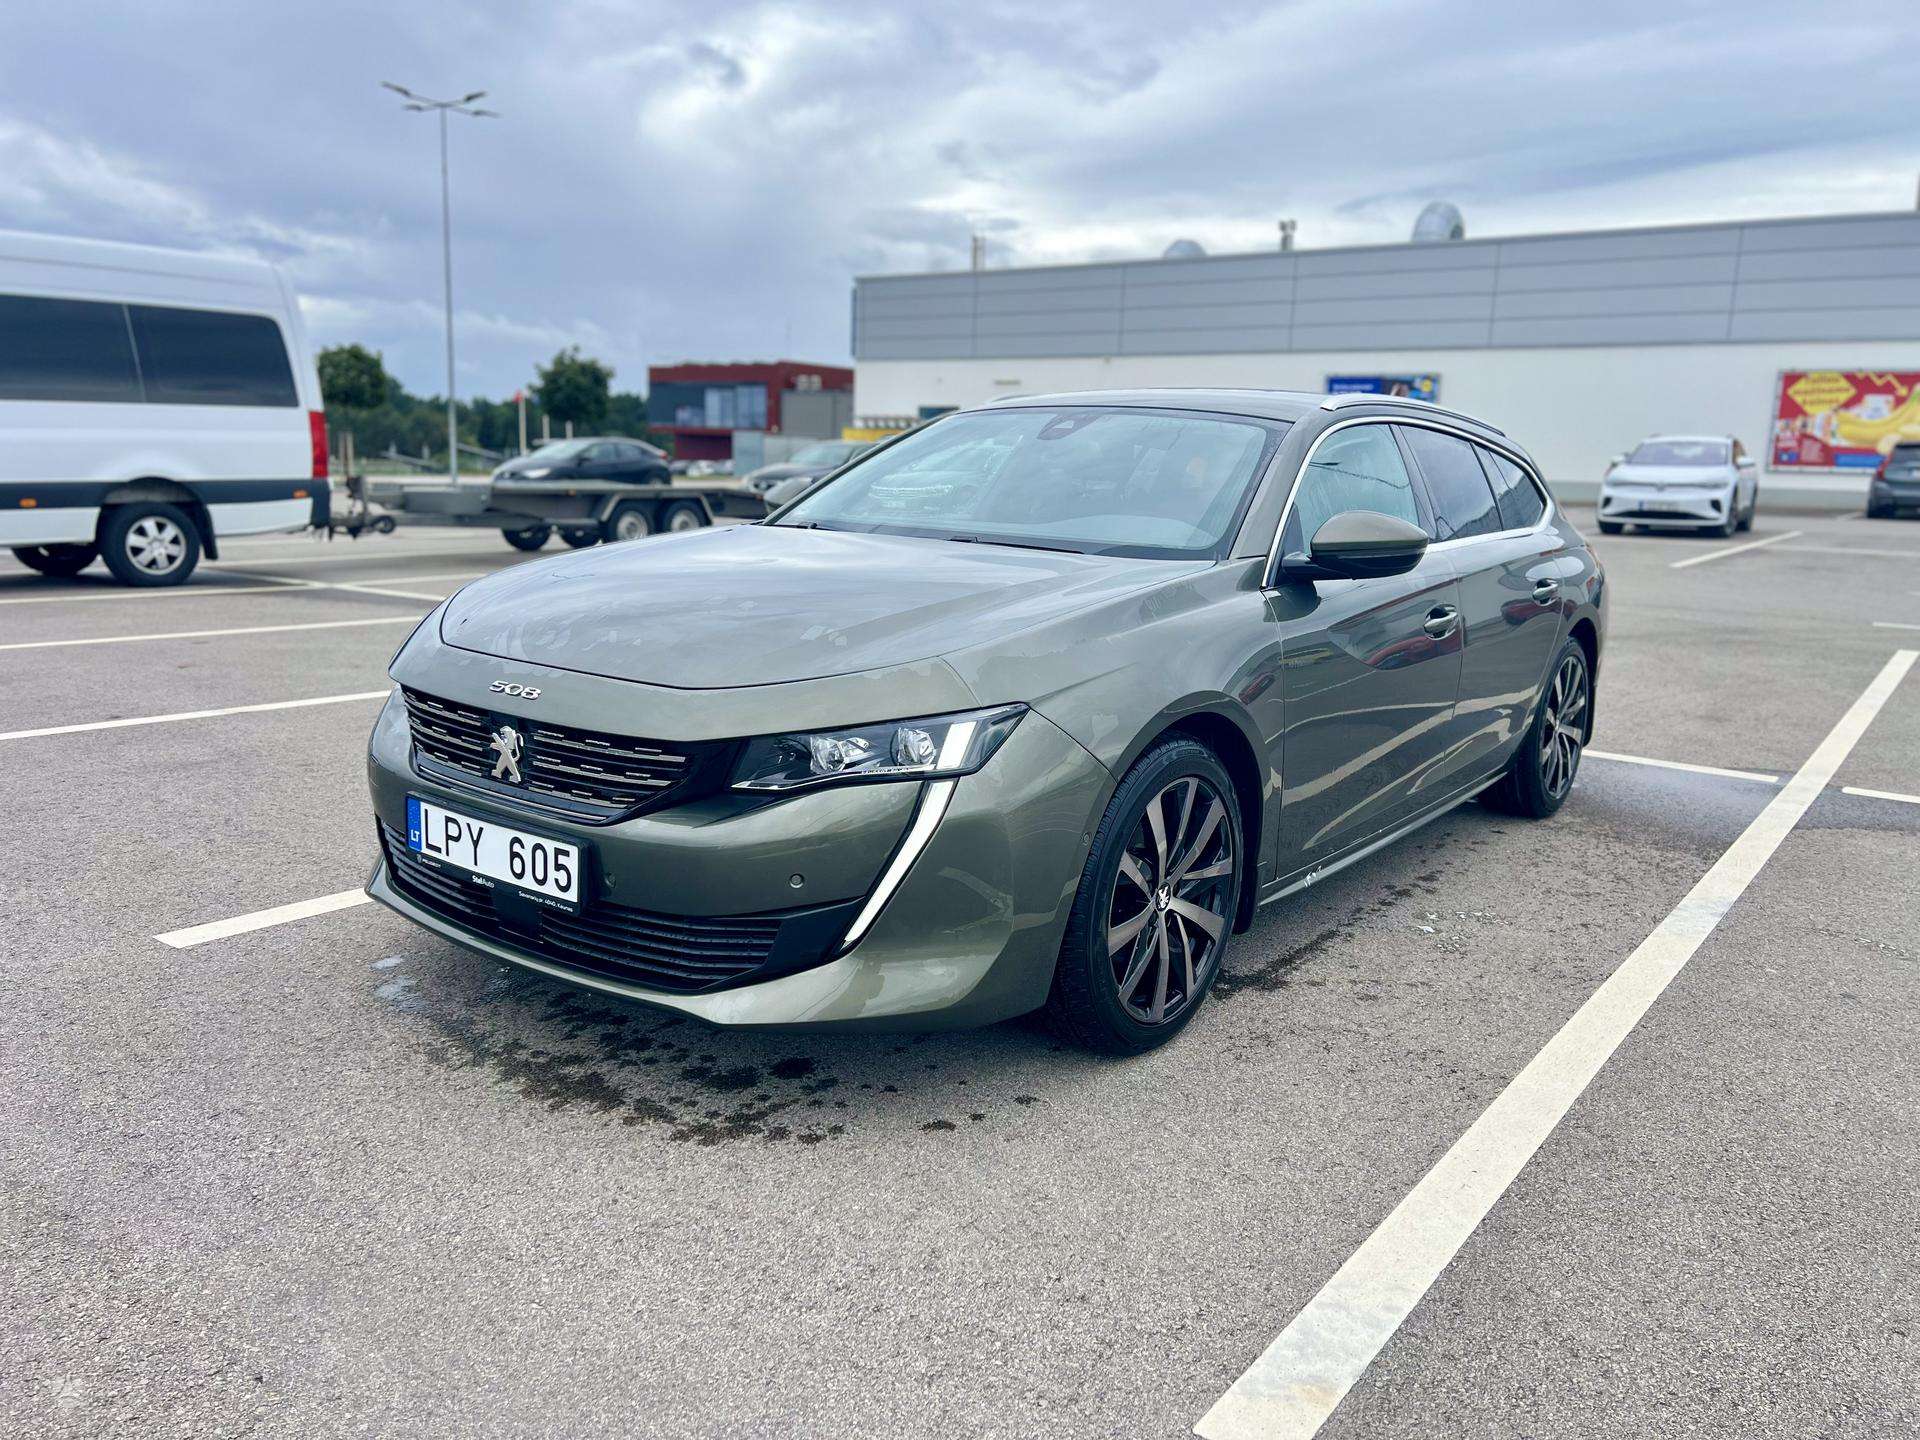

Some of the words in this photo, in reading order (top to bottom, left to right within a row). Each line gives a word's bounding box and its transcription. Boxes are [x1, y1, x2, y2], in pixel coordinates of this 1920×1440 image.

[489, 680, 541, 700] 508
[411, 829, 420, 842] LT
[424, 808, 484, 867] LPY
[509, 836, 571, 892] 605
